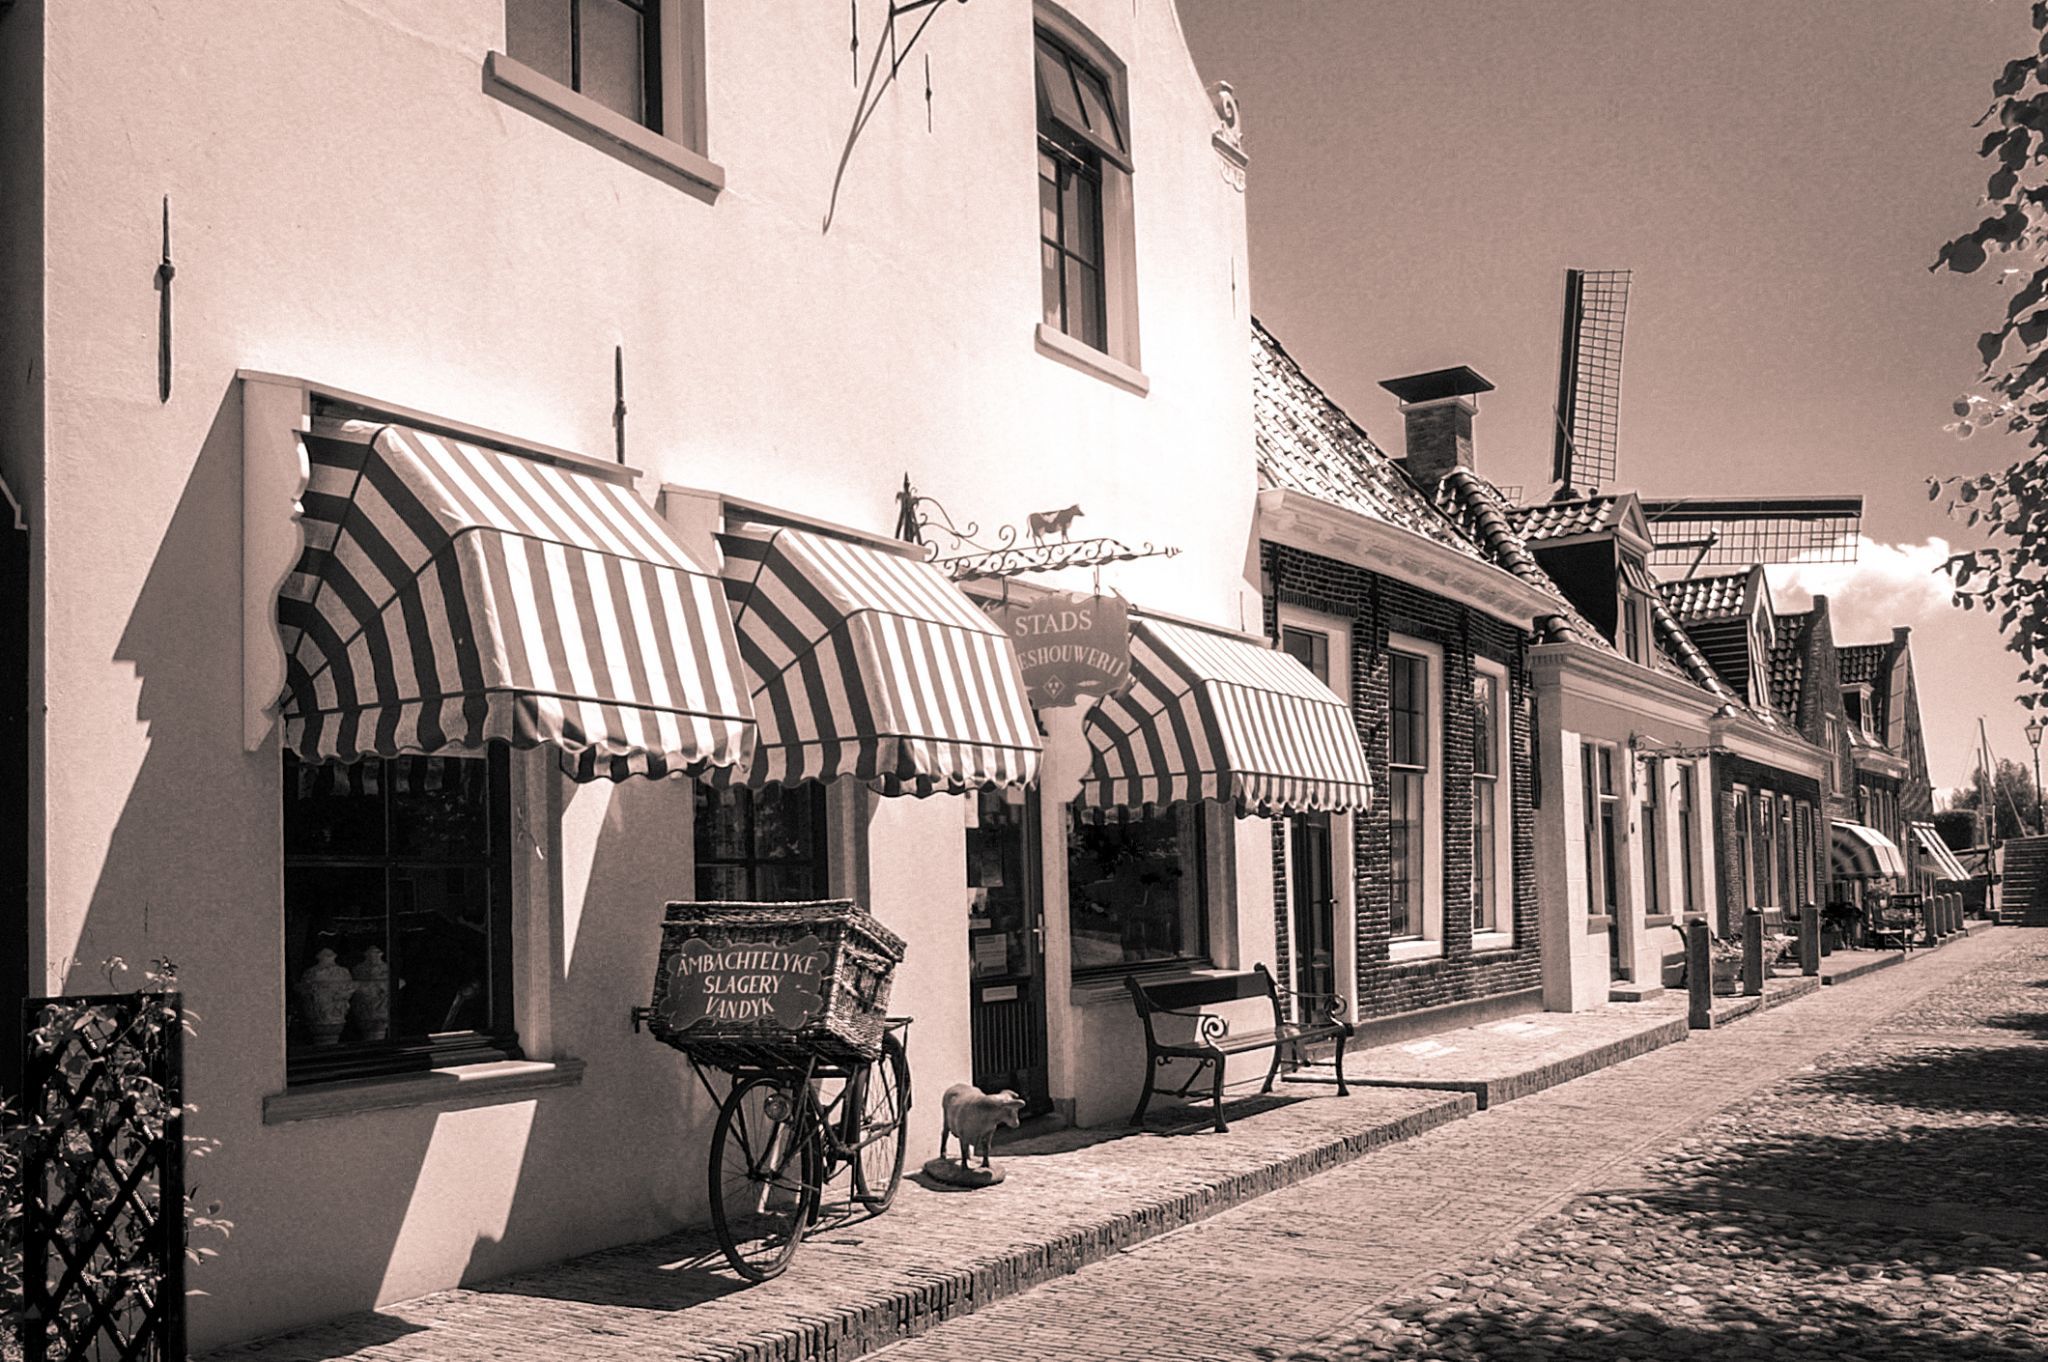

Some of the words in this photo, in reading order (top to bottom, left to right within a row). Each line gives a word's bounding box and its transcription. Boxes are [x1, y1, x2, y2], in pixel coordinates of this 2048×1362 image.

[1015, 609, 1092, 637] STADS
[1018, 645, 1125, 677] ESHOUWERIJ
[677, 951, 818, 976] AMBACHTELYKE
[703, 975, 783, 994] SLAGERY
